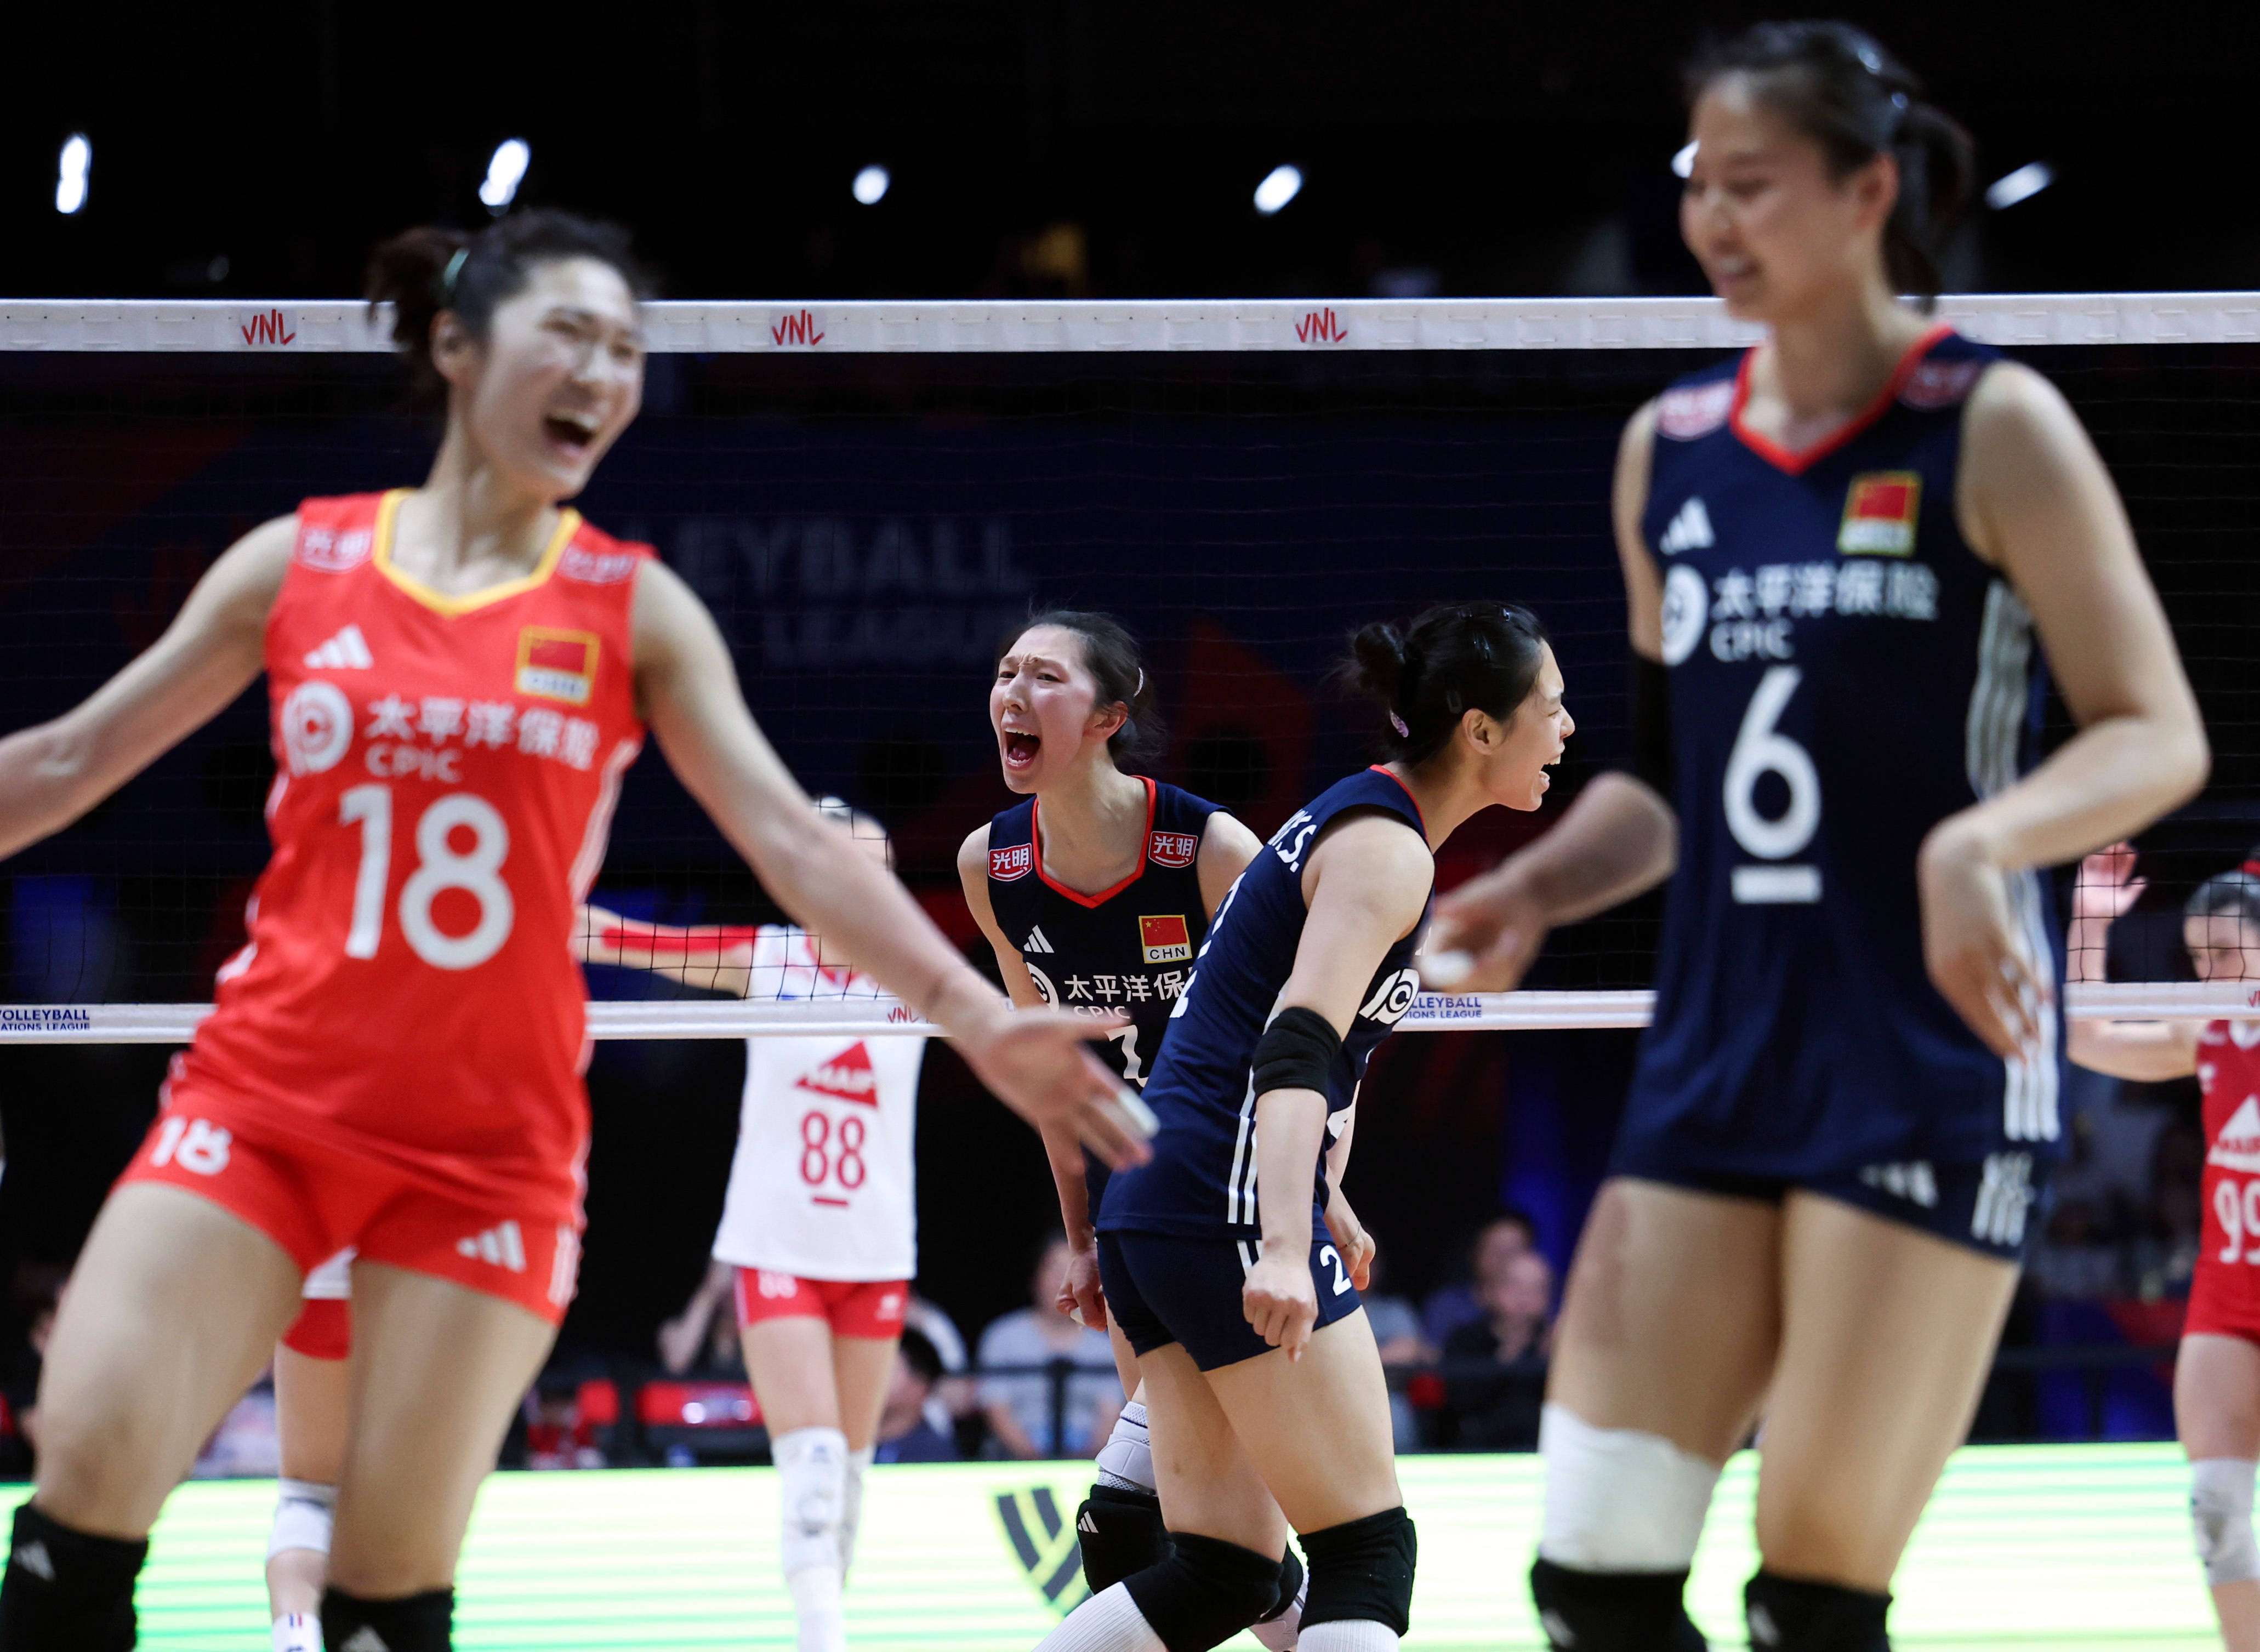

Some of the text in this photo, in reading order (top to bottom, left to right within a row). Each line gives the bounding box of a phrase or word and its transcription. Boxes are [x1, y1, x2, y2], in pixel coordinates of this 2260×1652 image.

[241, 309, 295, 345] VNL
[772, 309, 824, 346] VNL
[1295, 307, 1347, 343] VNL
[625, 513, 1032, 595] EYBALL
[364, 742, 464, 783] CPIC
[1722, 665, 1822, 860] 6
[993, 847, 1029, 871] 光明
[1153, 835, 1194, 857] 光明
[338, 783, 514, 971] 18
[1149, 946, 1186, 960] CHN
[1064, 967, 1193, 1003] 太平洋保
[47, 1023, 90, 1031] LEAGUE
[887, 1004, 919, 1024] VNL
[1073, 1005, 1131, 1019] CPIC
[1440, 1010, 1482, 1018] LEAGUE
[1105, 1024, 1142, 1079] 7
[151, 1115, 233, 1176] 18
[801, 1110, 866, 1189] 88
[1319, 1244, 1352, 1296] 2
